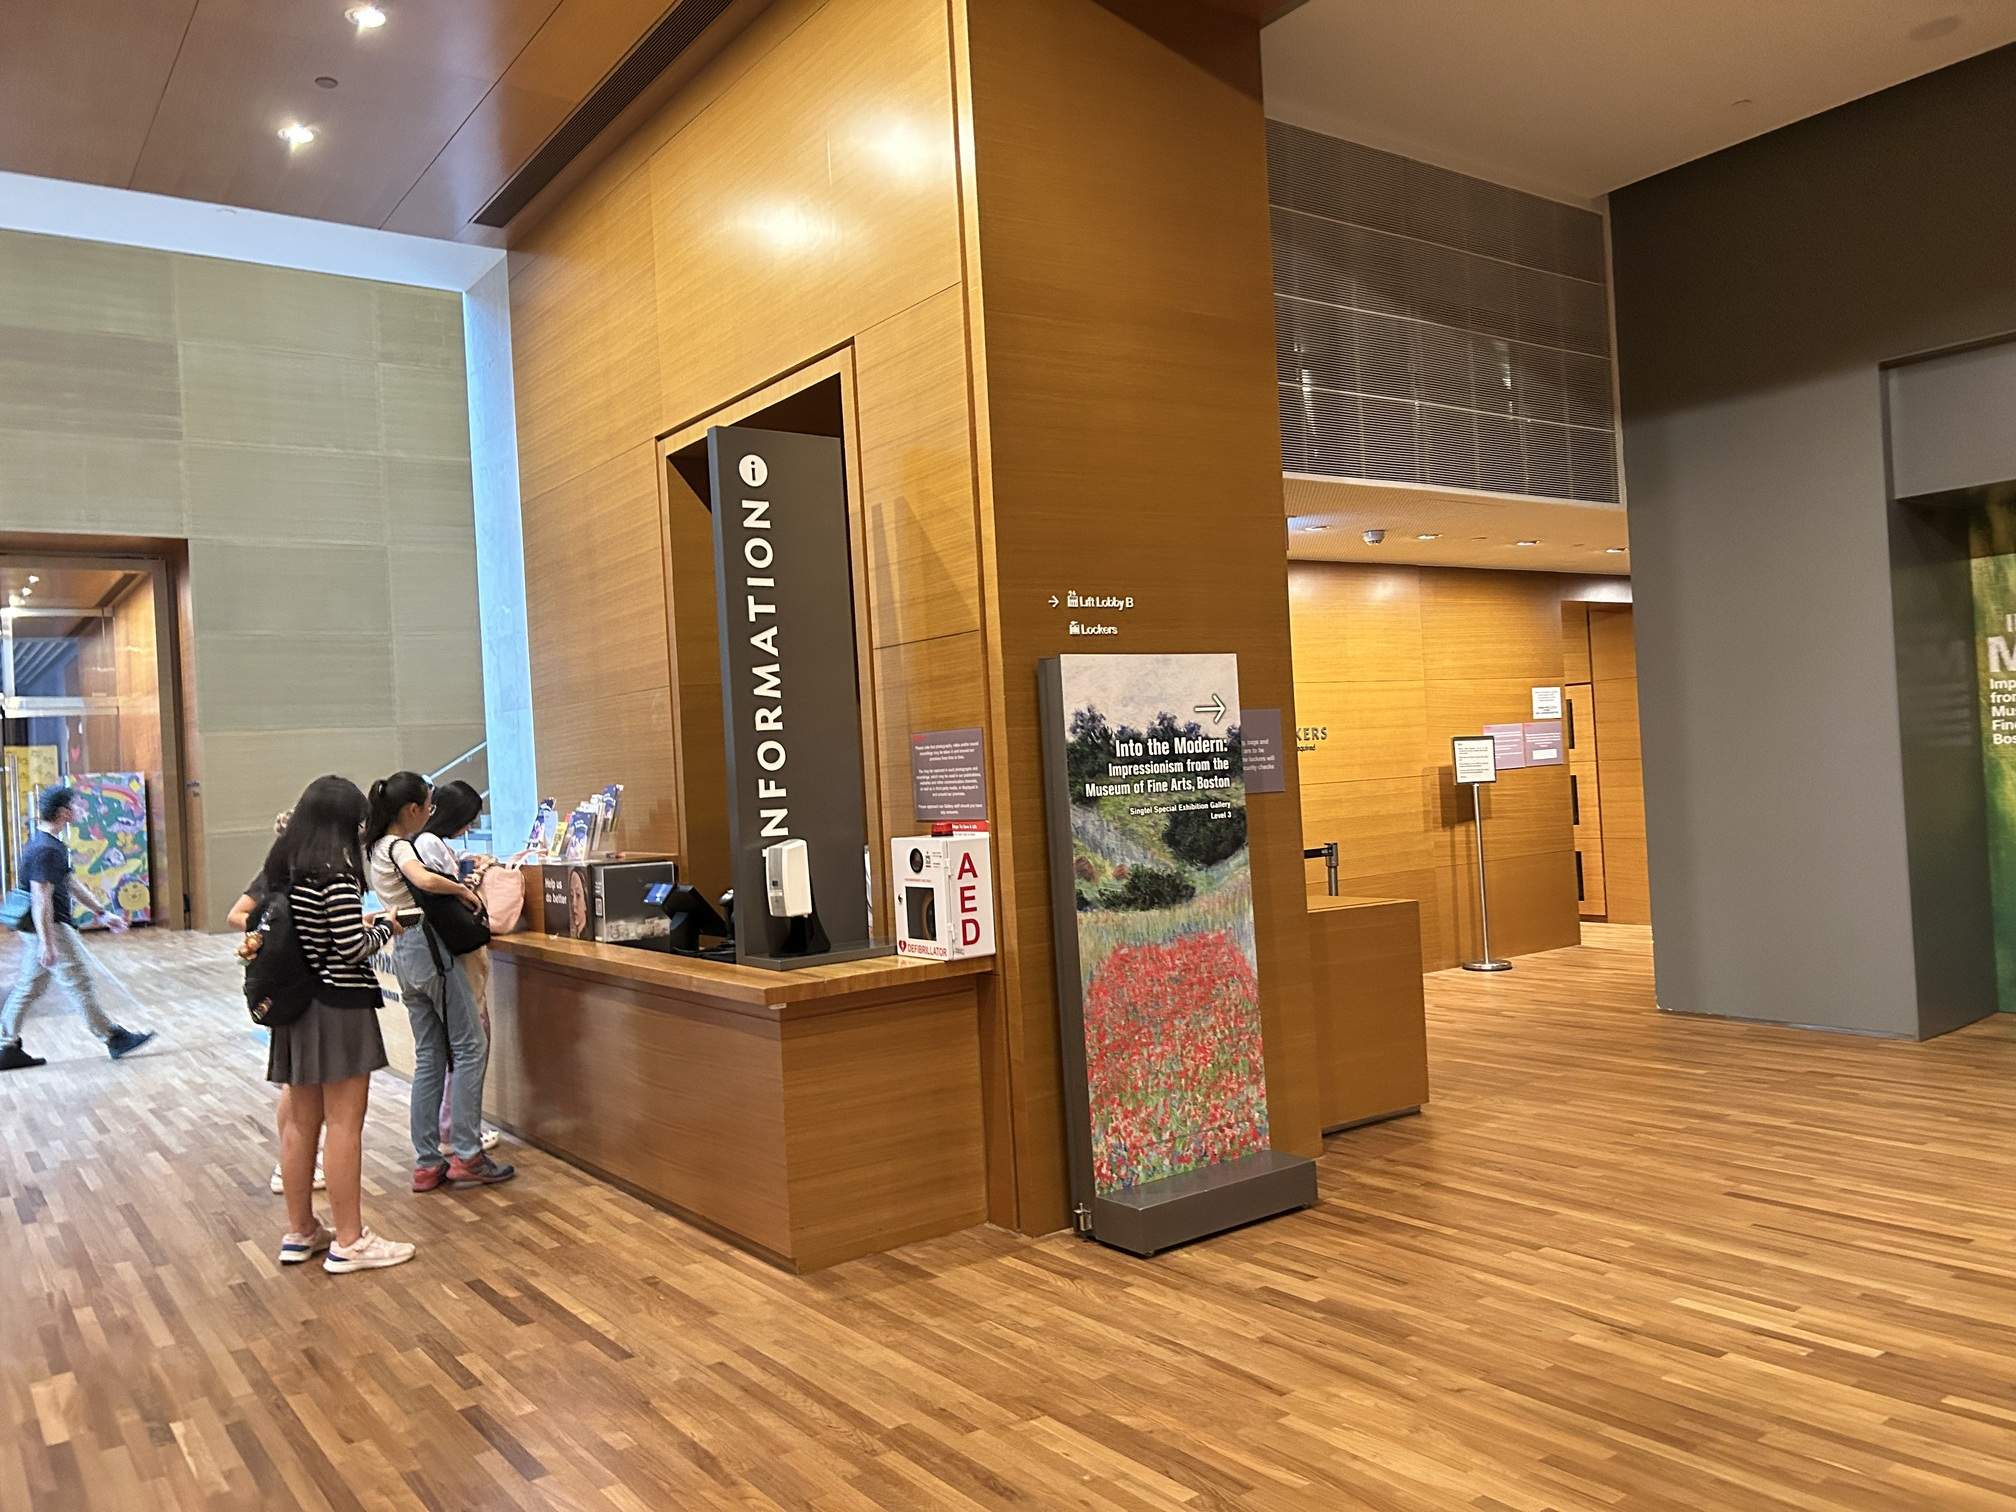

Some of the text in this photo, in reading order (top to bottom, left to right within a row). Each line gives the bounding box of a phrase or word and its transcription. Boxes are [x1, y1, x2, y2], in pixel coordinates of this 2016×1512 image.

[1080, 596, 1134, 611] Lift Lobby B
[1081, 624, 1118, 635] Lockers
[741, 499, 789, 858] NFORMATION
[1992, 719, 2016, 731] Fin
[1115, 736, 1228, 758] Into the Modern:
[1108, 760, 1184, 779] Impressionism
[1186, 758, 1210, 772] from
[1212, 757, 1230, 770] the
[1085, 775, 1231, 797] Museum of Fine Arts, Boston
[1153, 805, 1177, 813] Special
[1178, 803, 1209, 812] Exhibition
[1209, 801, 1231, 810] Gallery
[1210, 811, 1232, 820] Level 3
[544, 877, 563, 891] Help us
[552, 893, 567, 905] better
[957, 852, 981, 946] AED
[907, 942, 948, 957] DEFIBRILLATOR
